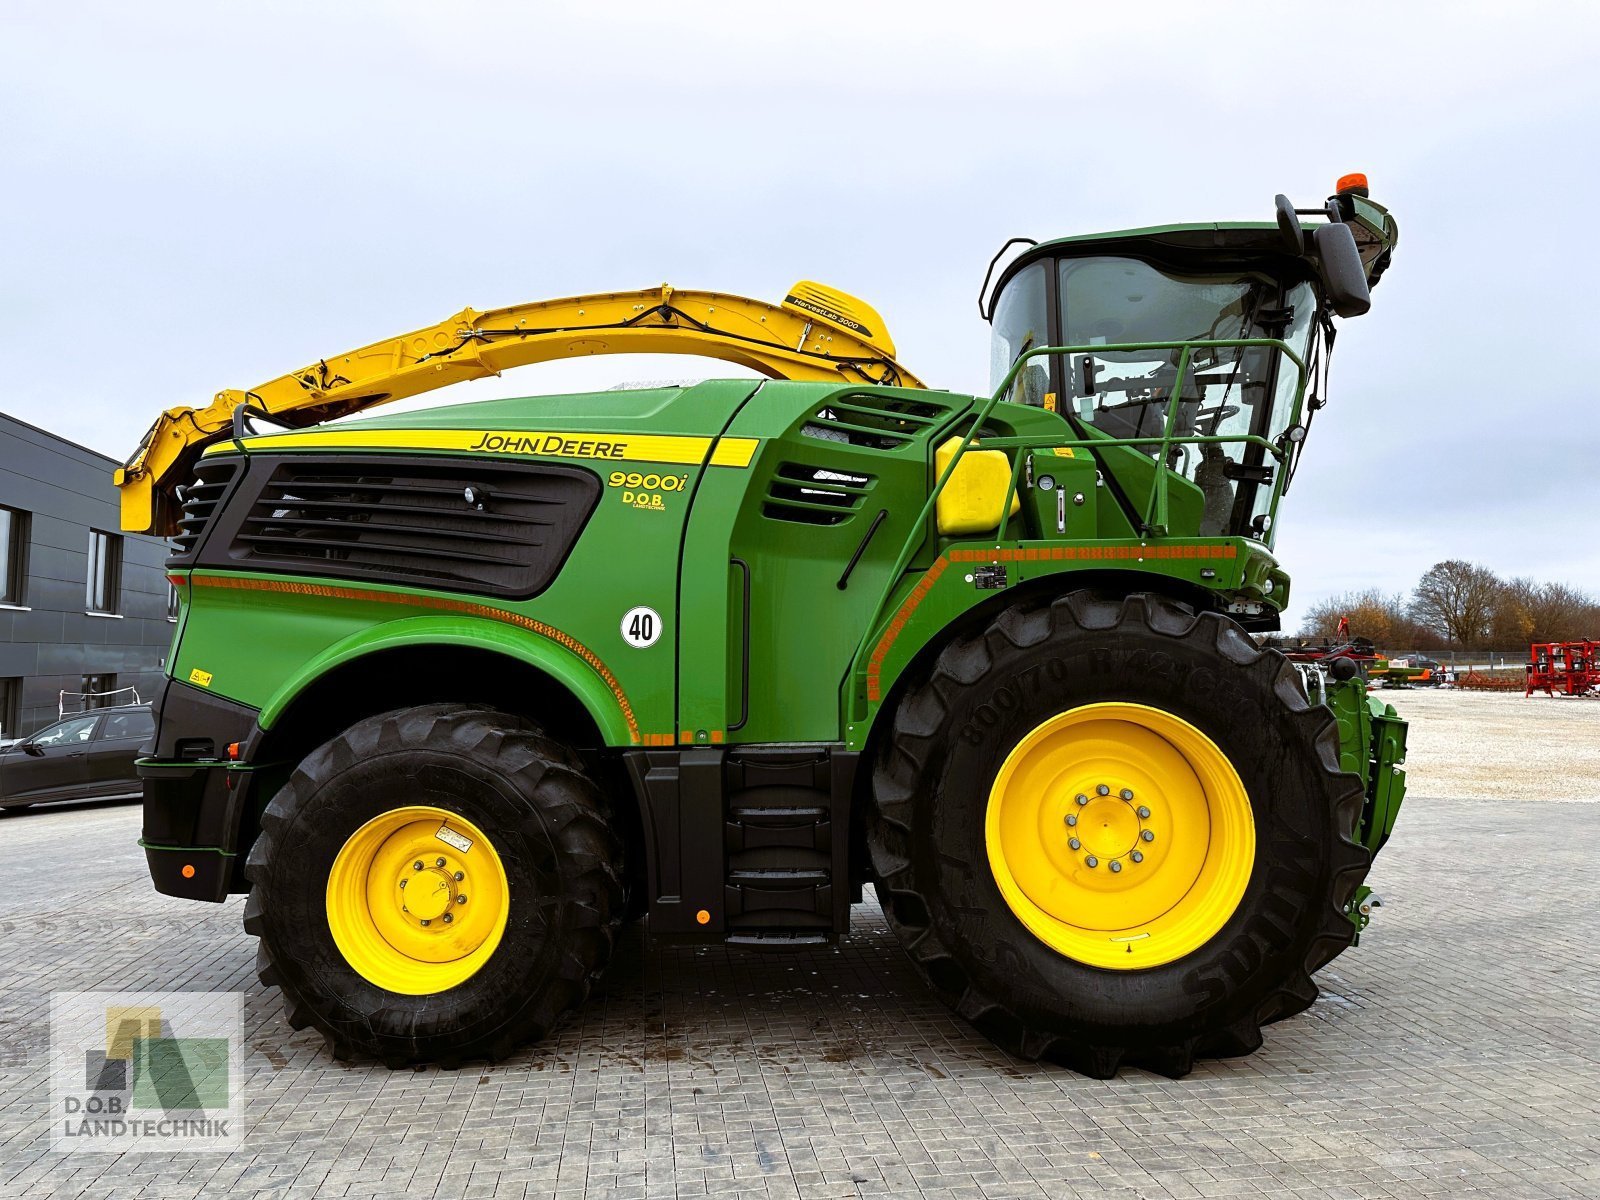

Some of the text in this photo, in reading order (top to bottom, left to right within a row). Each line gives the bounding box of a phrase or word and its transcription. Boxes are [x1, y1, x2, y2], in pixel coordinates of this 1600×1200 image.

[793, 298, 859, 330] HarvestLab 3000
[470, 432, 628, 458] JOHN DEERE
[608, 471, 688, 492] 9900i
[622, 491, 665, 507] D.O.B.
[628, 613, 653, 641] 40
